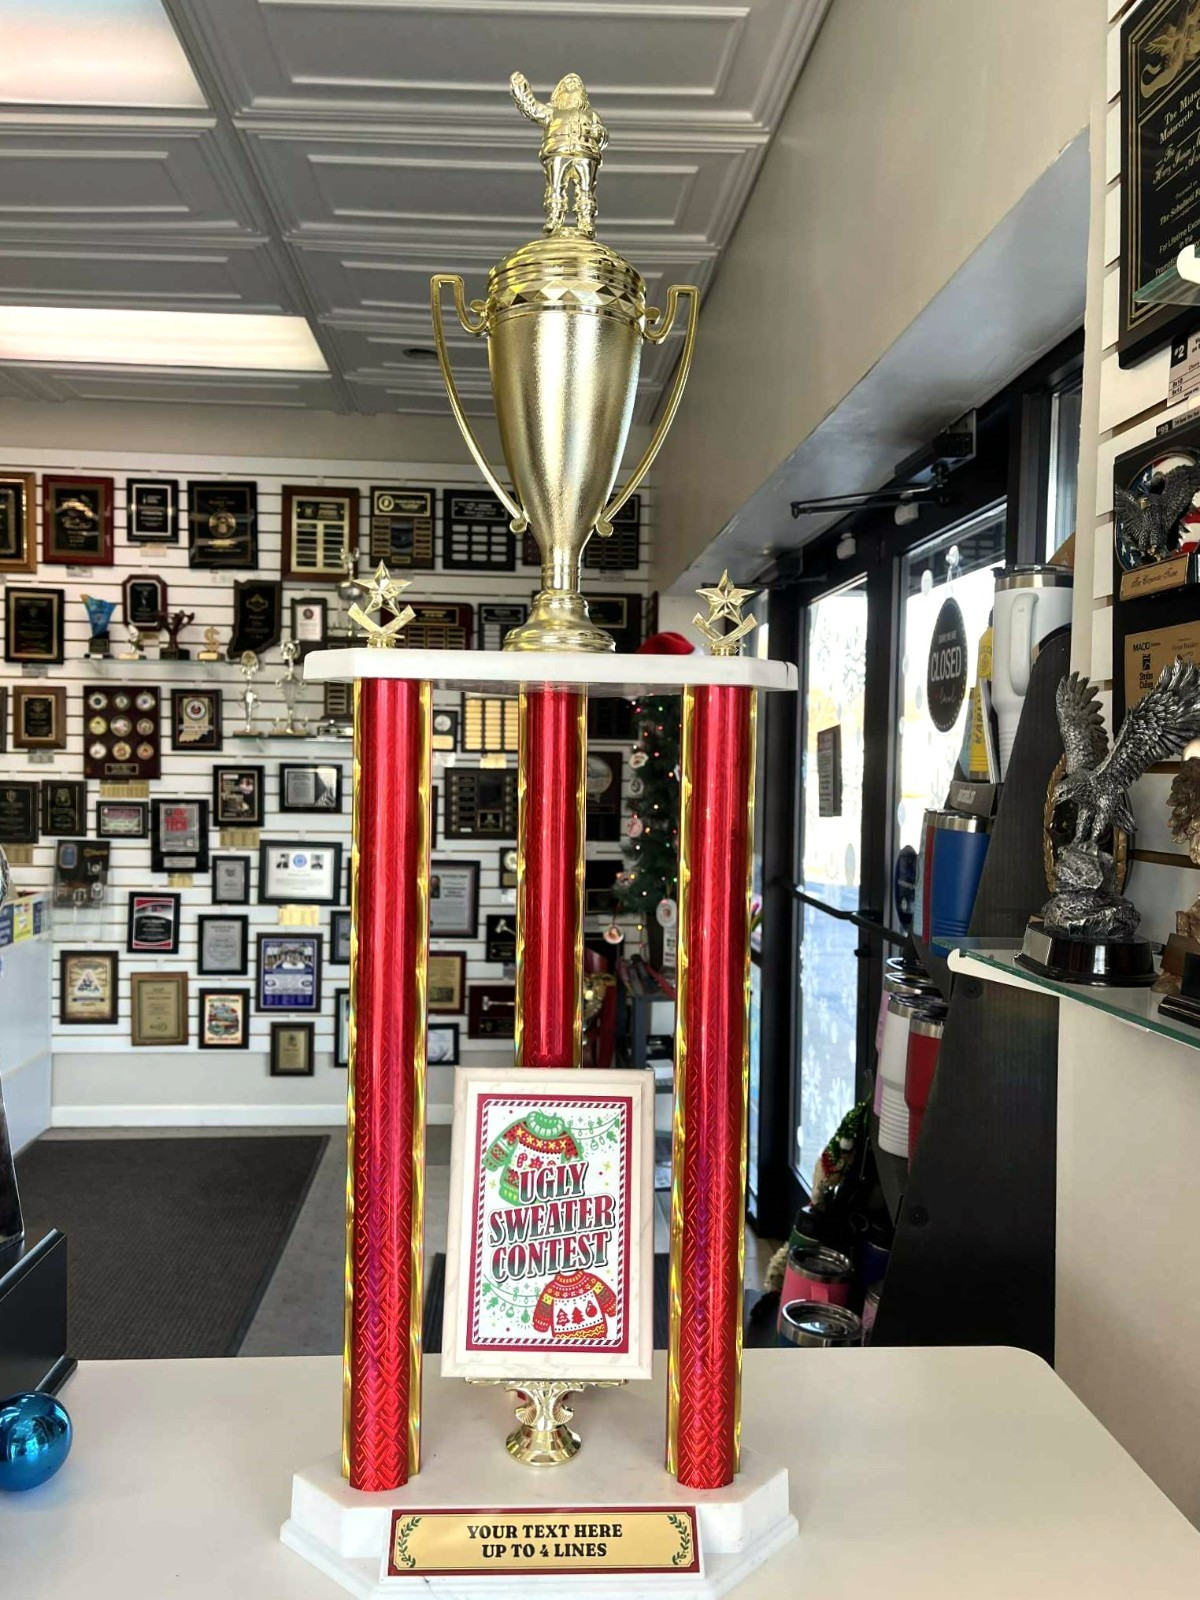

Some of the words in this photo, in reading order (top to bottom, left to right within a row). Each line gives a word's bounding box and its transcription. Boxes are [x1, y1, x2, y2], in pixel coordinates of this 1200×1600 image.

[1159, 110, 1194, 144] Motorcycle
[1164, 111, 1178, 126] The
[1159, 242, 1168, 254] For
[1168, 228, 1187, 248] Lifetime
[1174, 344, 1185, 359] #2
[931, 646, 961, 682] CLOSED
[518, 1161, 587, 1205] UGLY
[489, 1195, 615, 1247] SWEATER
[491, 1231, 613, 1282] CONTEST
[467, 1524, 518, 1540] YOUR
[522, 1524, 570, 1539] TEXT
[574, 1523, 623, 1538] HERE
[482, 1544, 507, 1559] UP
[510, 1544, 536, 1558] TO
[539, 1544, 550, 1558] 4
[553, 1542, 607, 1558] LINES
